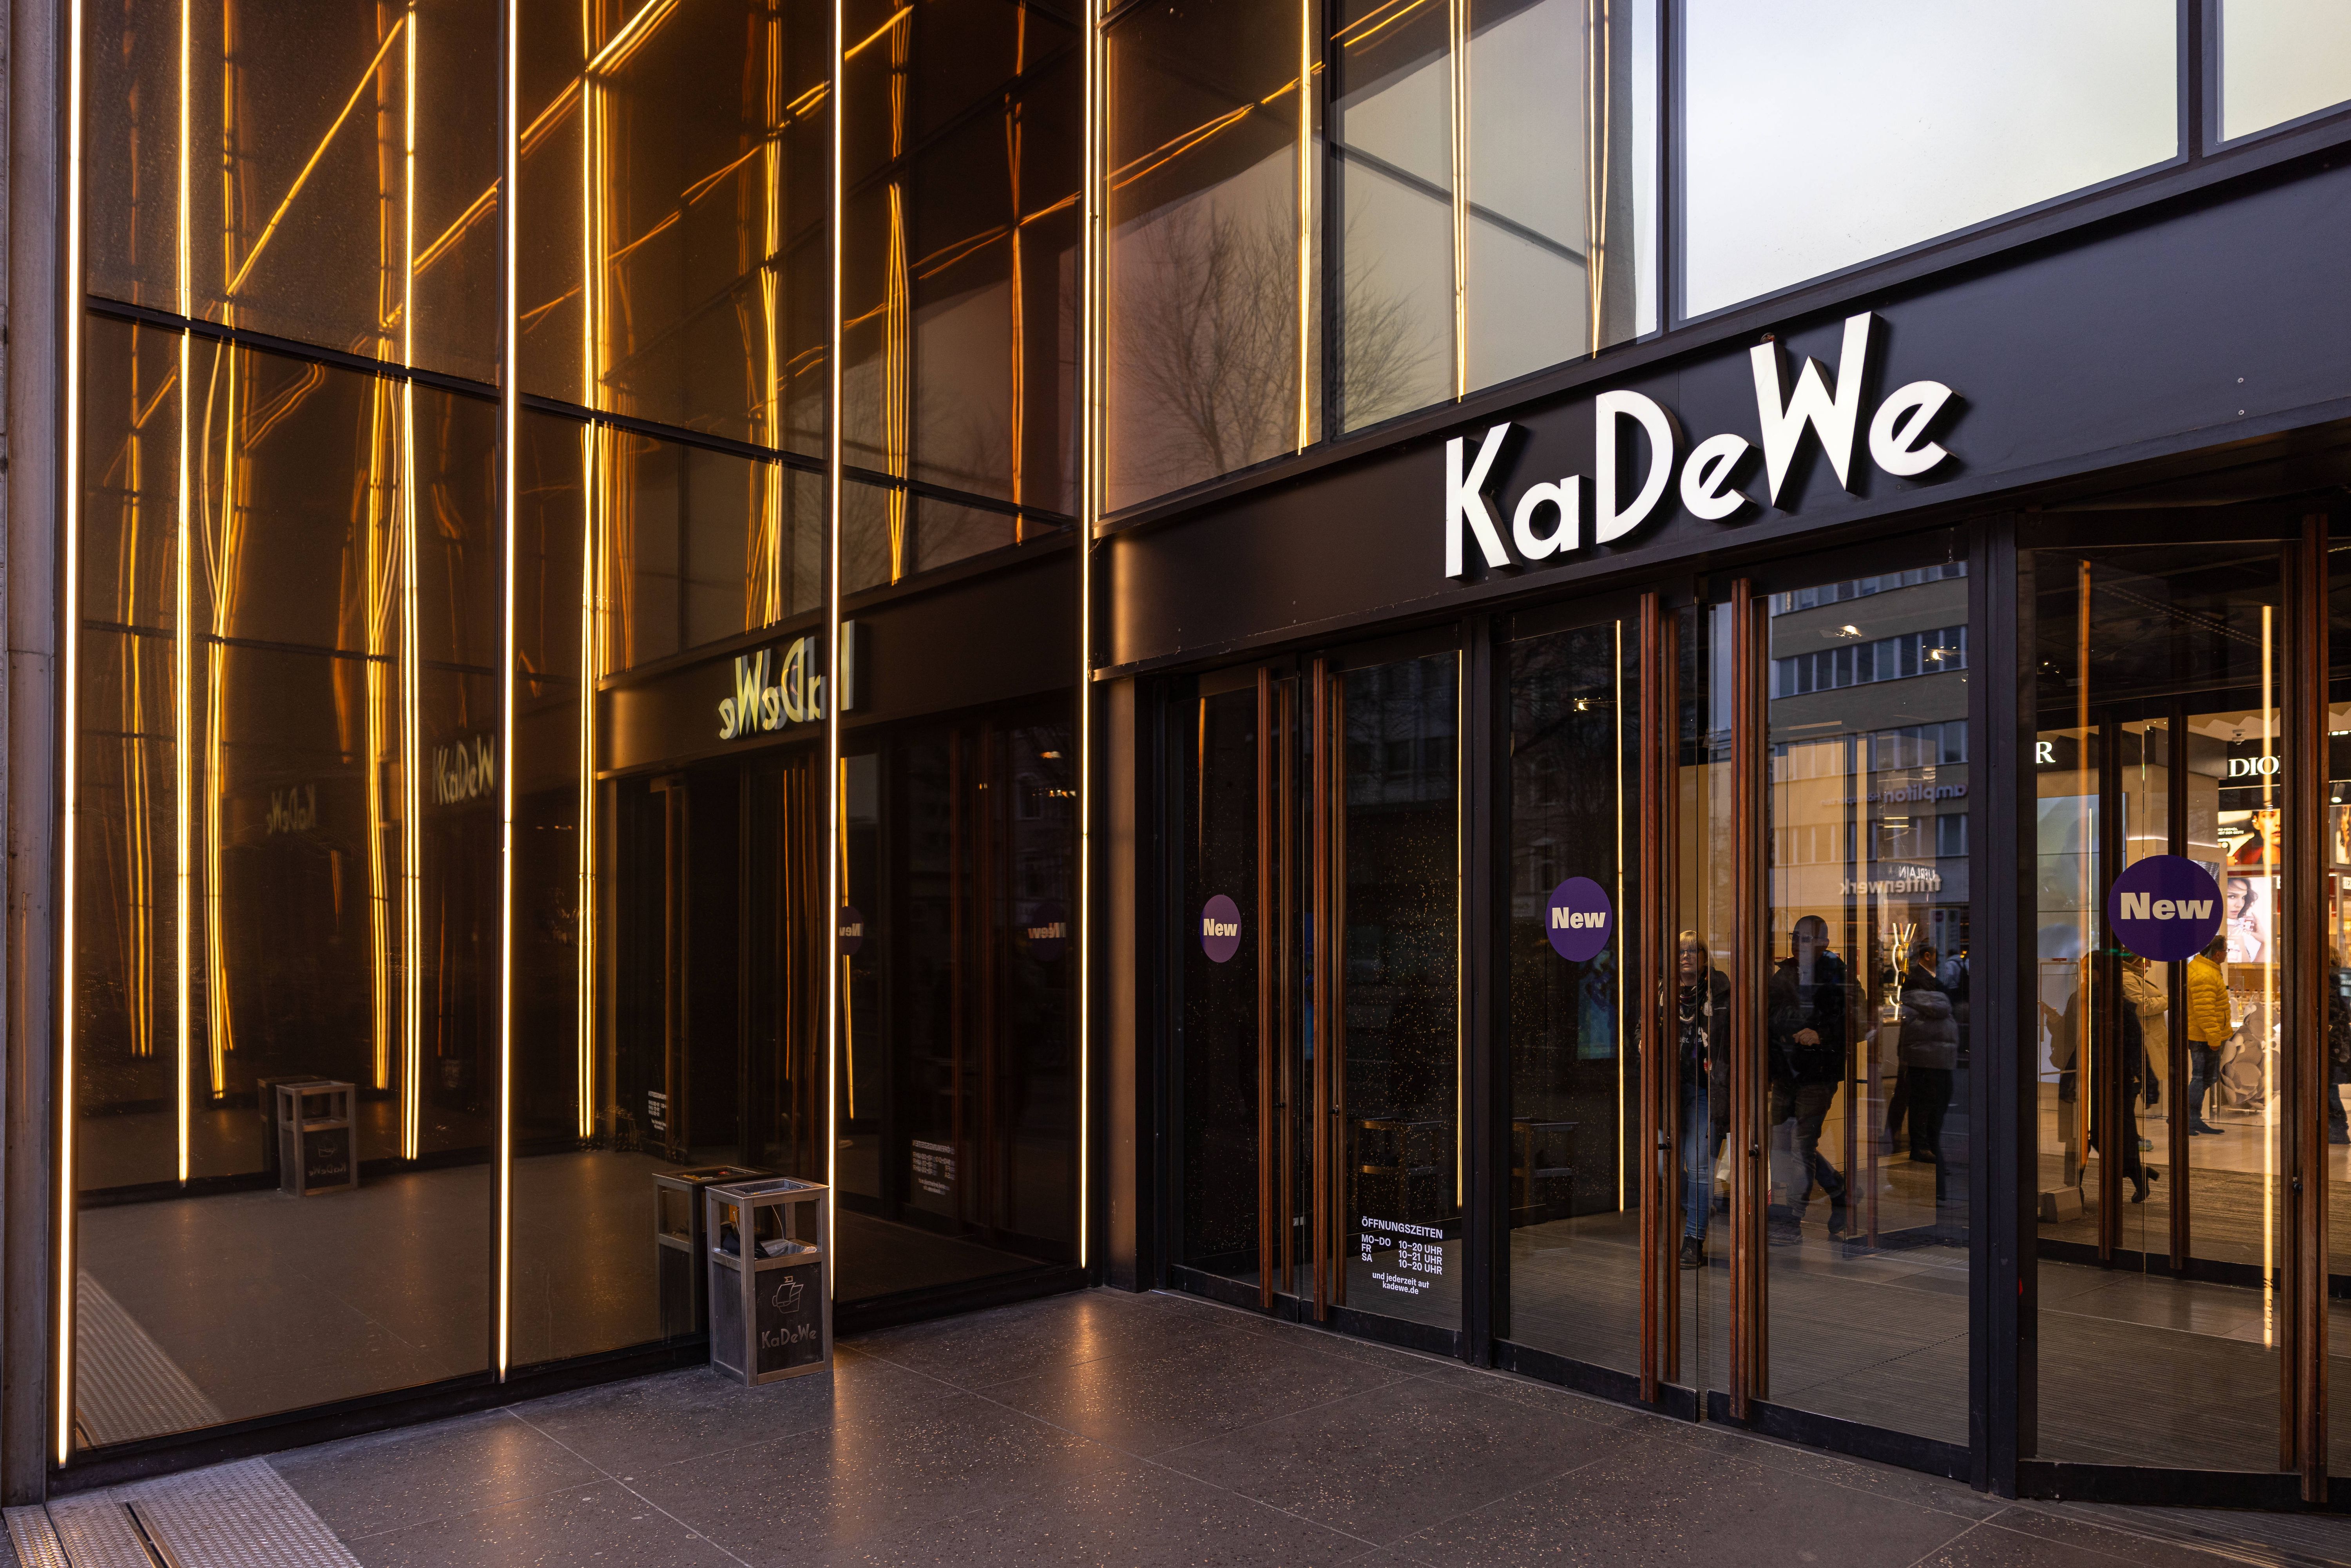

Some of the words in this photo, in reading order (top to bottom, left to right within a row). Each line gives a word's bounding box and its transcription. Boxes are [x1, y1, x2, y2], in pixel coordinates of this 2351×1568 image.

[1446, 311, 1956, 579] KaDeWe
[438, 734, 494, 805] KaDeW
[2228, 755, 2280, 777] DIO
[2121, 892, 2213, 920] New
[1203, 918, 1237, 936] New
[1552, 907, 1606, 929] New
[1362, 1216, 1442, 1239] ÖFFNUNGSZEITEN
[1361, 1244, 1371, 1253] FR
[1424, 1255, 1442, 1265] UHR
[1424, 1246, 1442, 1255] UHR
[1362, 1253, 1372, 1262] SA
[1424, 1264, 1442, 1275] UHR
[1382, 1280, 1419, 1294] kadewe.de
[1386, 1273, 1416, 1286] jederzeit
[762, 1324, 817, 1349] KaDeWe
